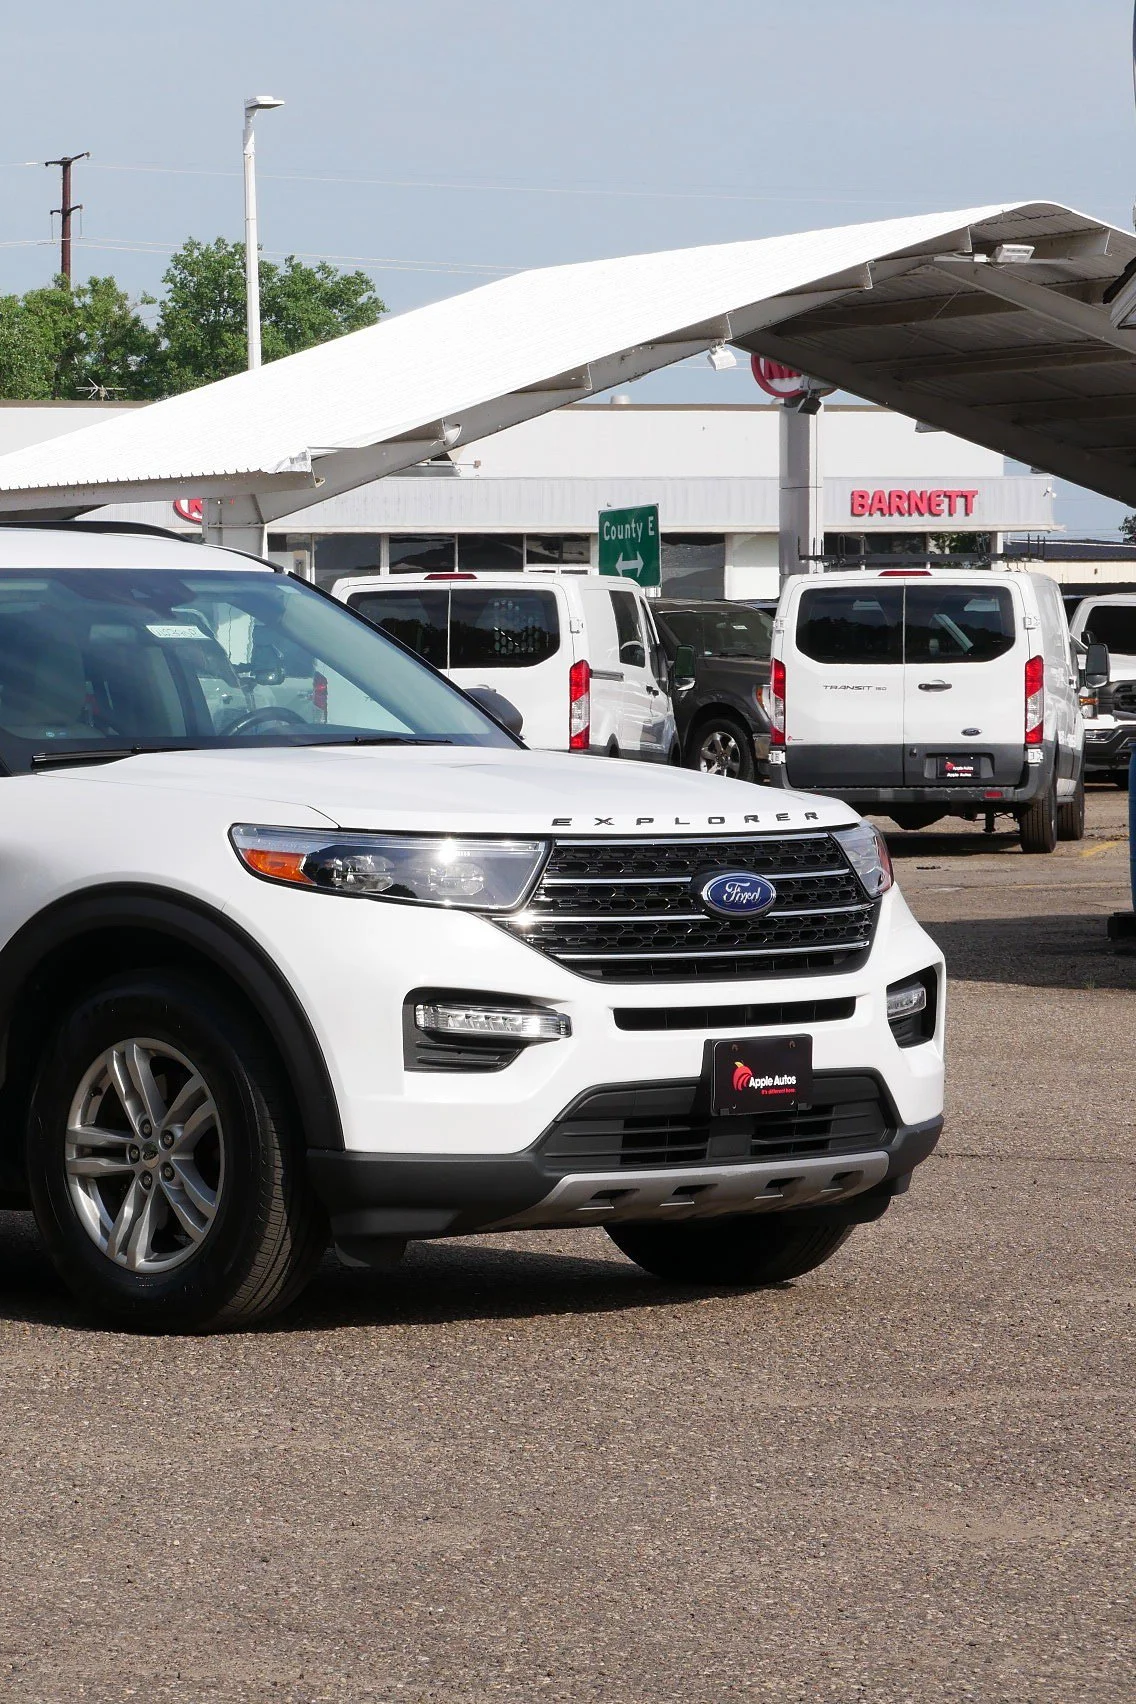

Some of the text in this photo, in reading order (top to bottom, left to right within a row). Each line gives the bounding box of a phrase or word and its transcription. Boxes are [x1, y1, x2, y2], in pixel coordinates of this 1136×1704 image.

[850, 489, 979, 516] BARNETT
[603, 516, 655, 543] County E
[551, 811, 820, 827] EXPLORER
[723, 881, 762, 904] Ford
[749, 1075, 796, 1088] Apple Autos
